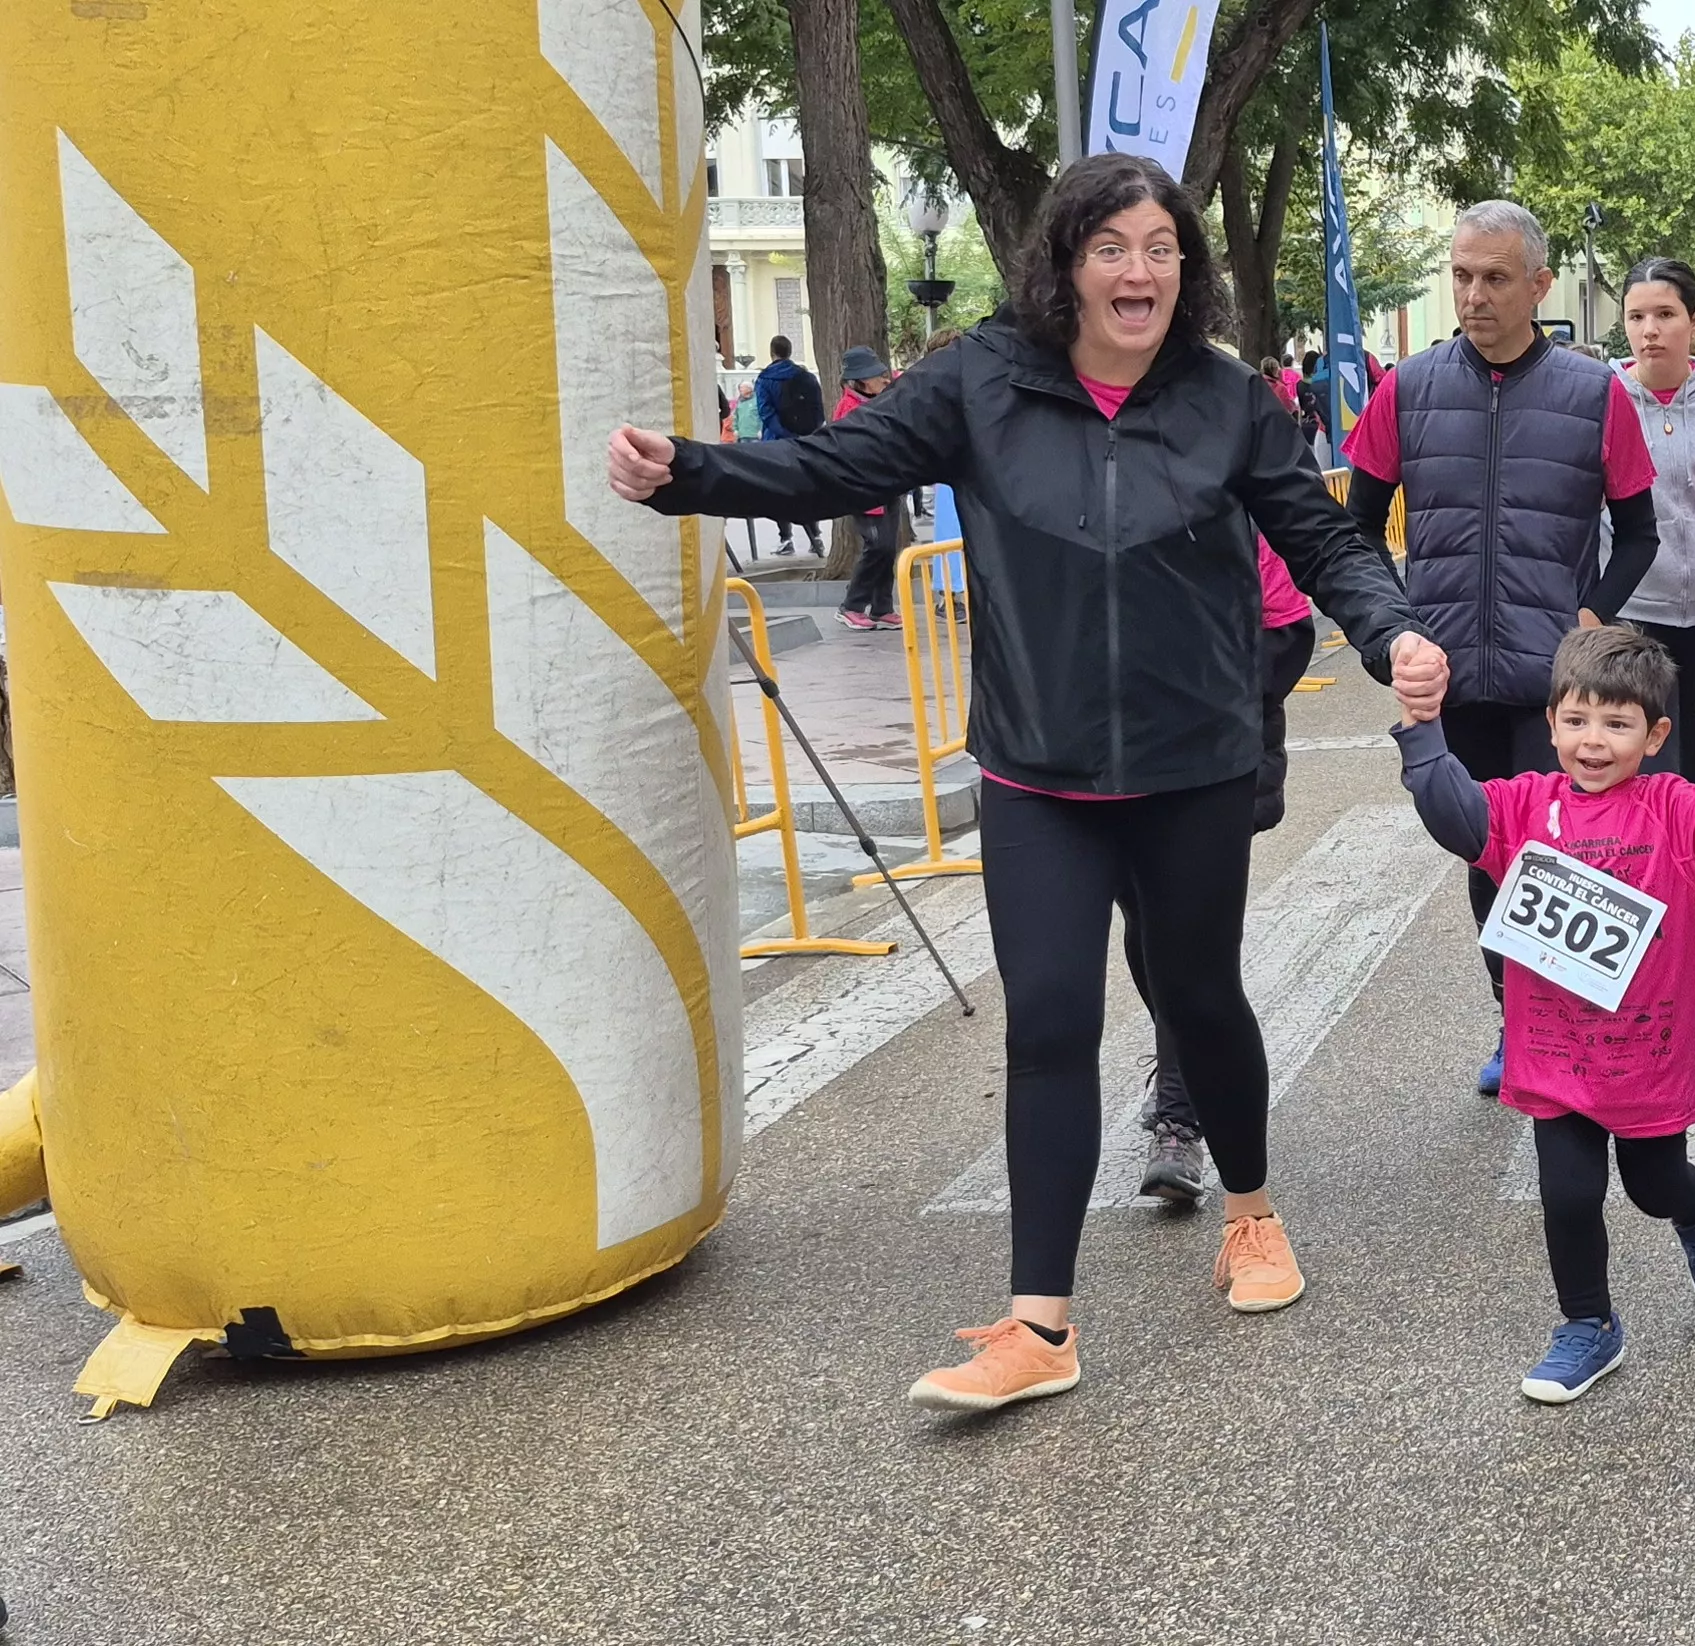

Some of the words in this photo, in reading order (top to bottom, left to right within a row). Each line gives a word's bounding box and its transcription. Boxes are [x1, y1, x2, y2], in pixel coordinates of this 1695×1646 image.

[1106, 0, 1161, 153] CA
[1575, 837, 1621, 849] CARRERA
[1606, 849, 1616, 858] EL
[1528, 865, 1575, 897] CONTRA
[1575, 886, 1588, 901] EL
[1590, 893, 1640, 927] CÁNCER
[1569, 873, 1604, 896] HUESCA
[1509, 882, 1630, 973] 3502
